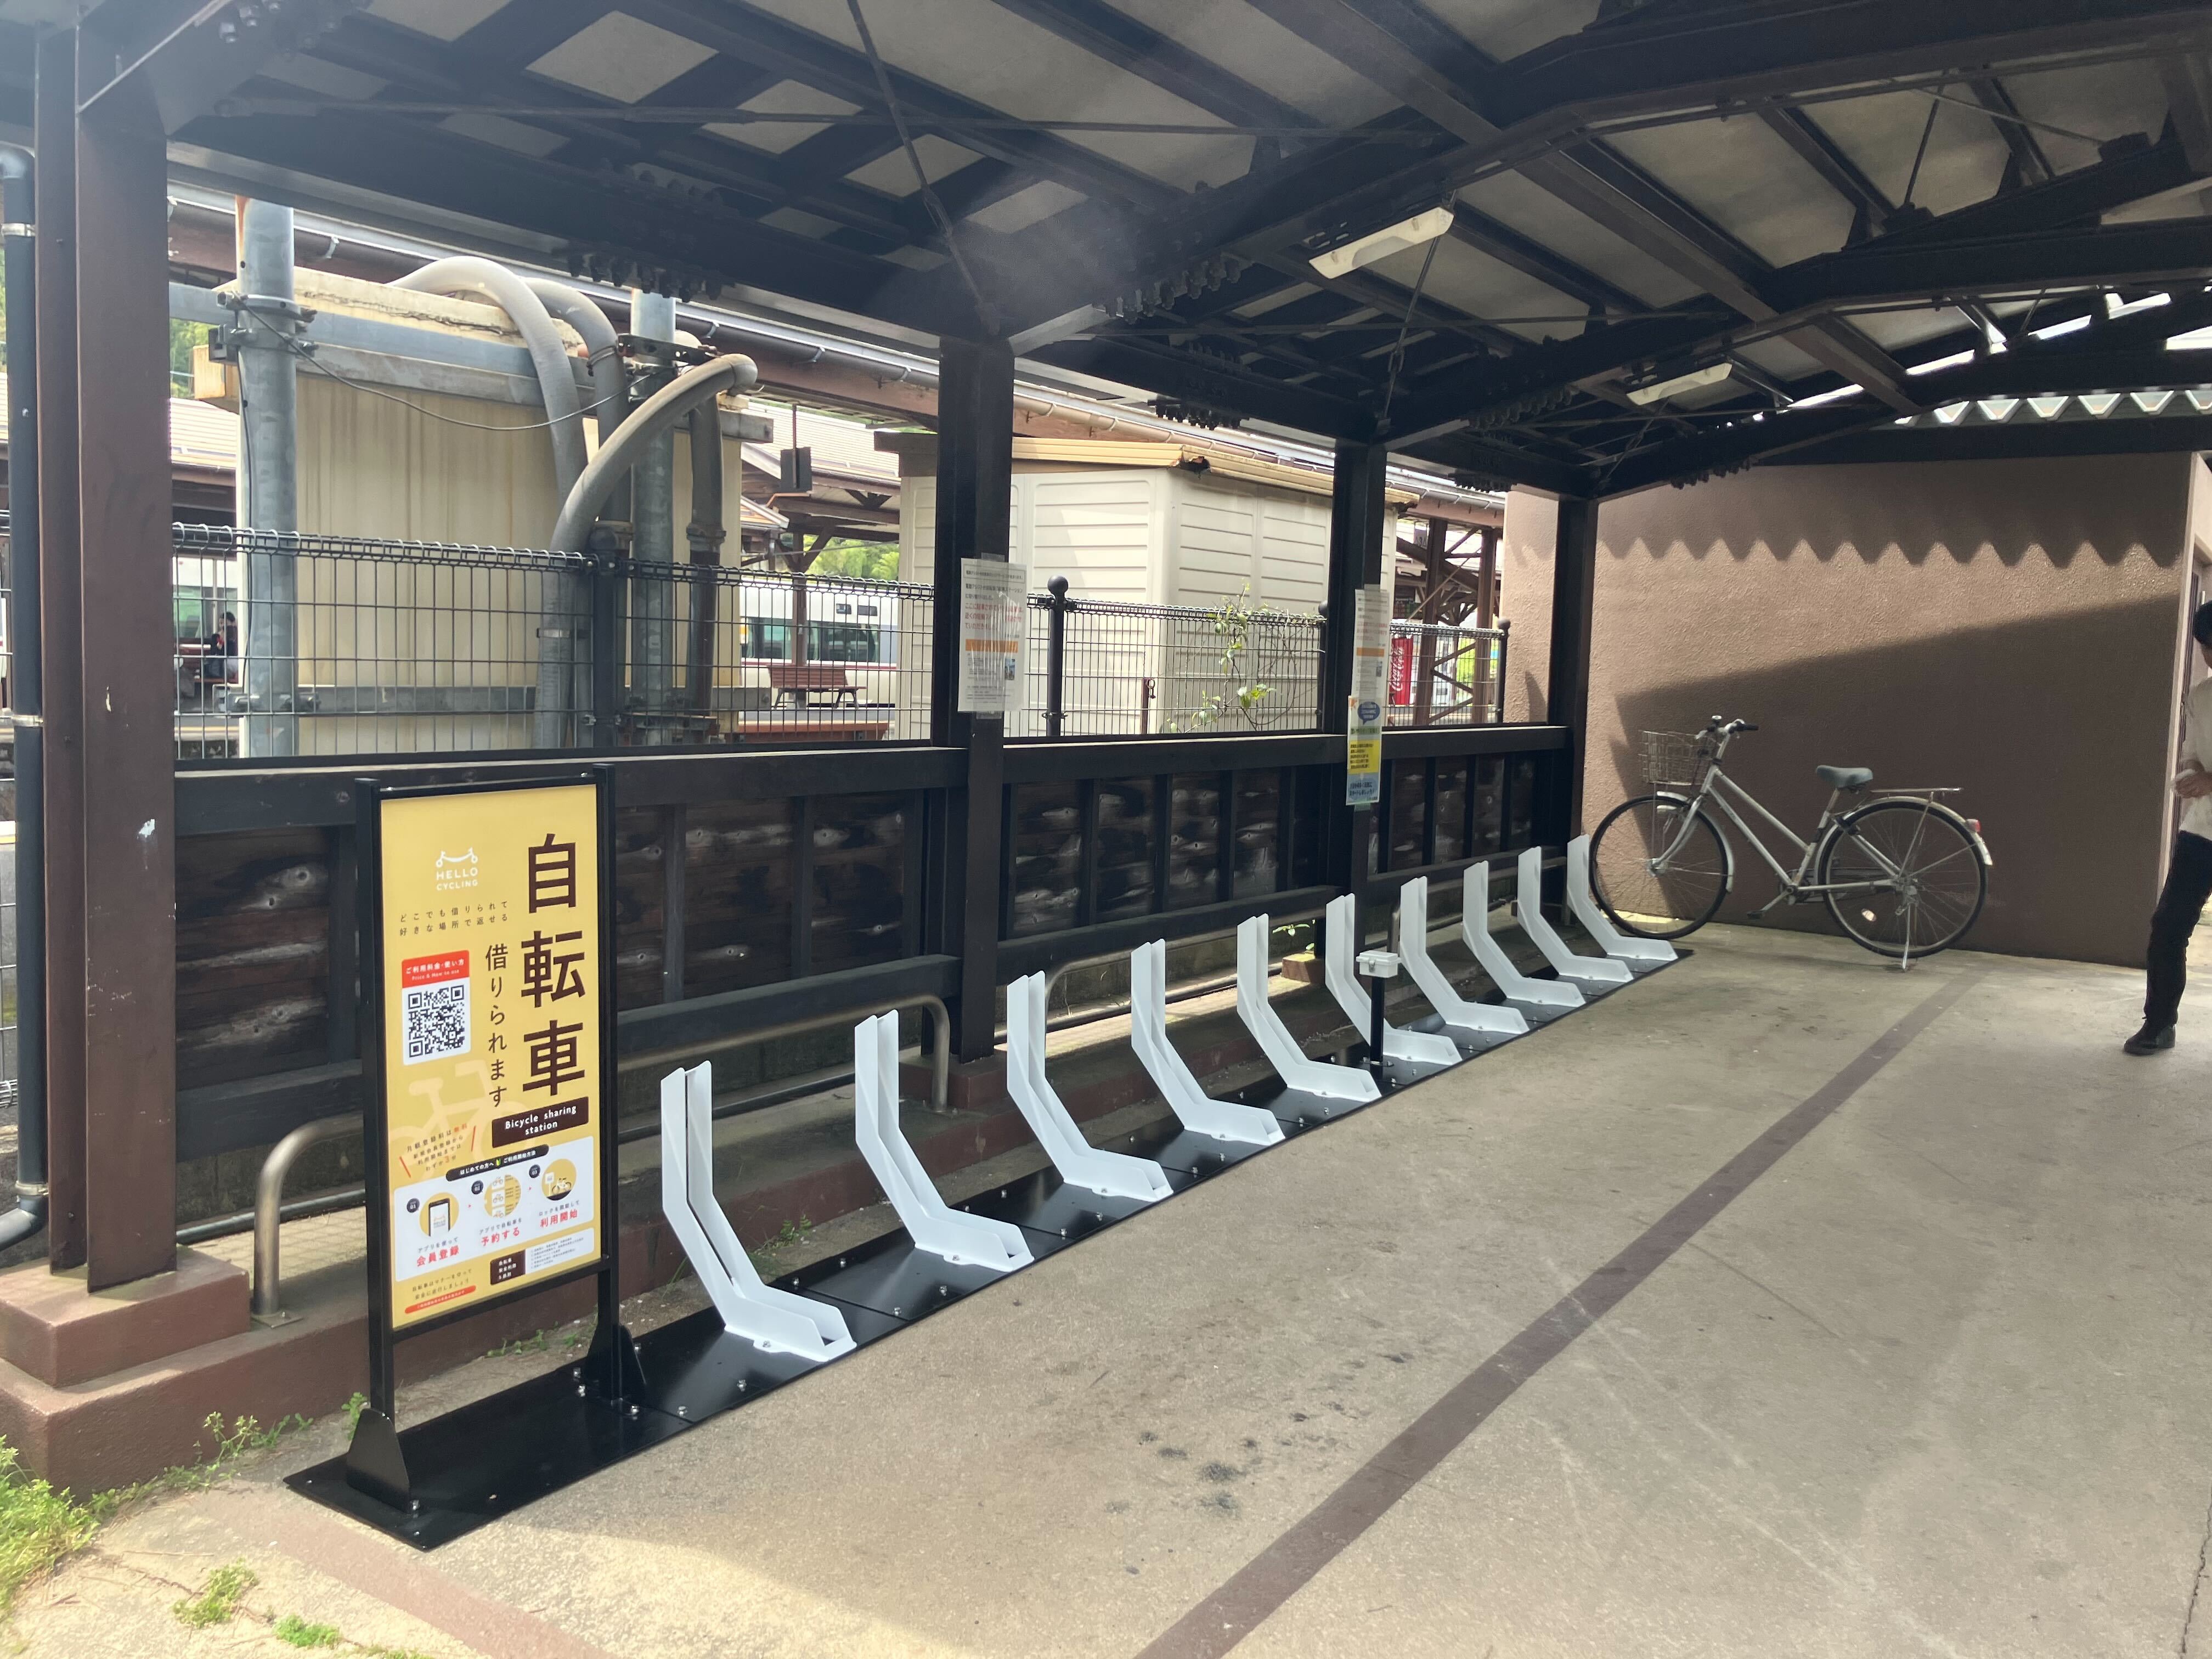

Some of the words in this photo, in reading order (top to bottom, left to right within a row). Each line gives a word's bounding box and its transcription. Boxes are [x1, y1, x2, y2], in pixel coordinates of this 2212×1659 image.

[436, 867, 478, 881] HELLO
[437, 879, 478, 891] CYCLING
[400, 901, 507, 922] どこでも借りられて
[400, 914, 507, 936] 好きな場所で返せる
[521, 833, 585, 1096] 自転車
[486, 944, 509, 1107] 借りられます
[505, 1114, 539, 1130] Bicycle
[544, 1105, 577, 1120] sharing
[525, 1121, 558, 1136] station
[460, 1163, 494, 1175] はじめての方へ
[540, 1209, 578, 1228] 利用開始
[481, 1227, 520, 1246] 予約する
[417, 1245, 459, 1267] 会員登録
